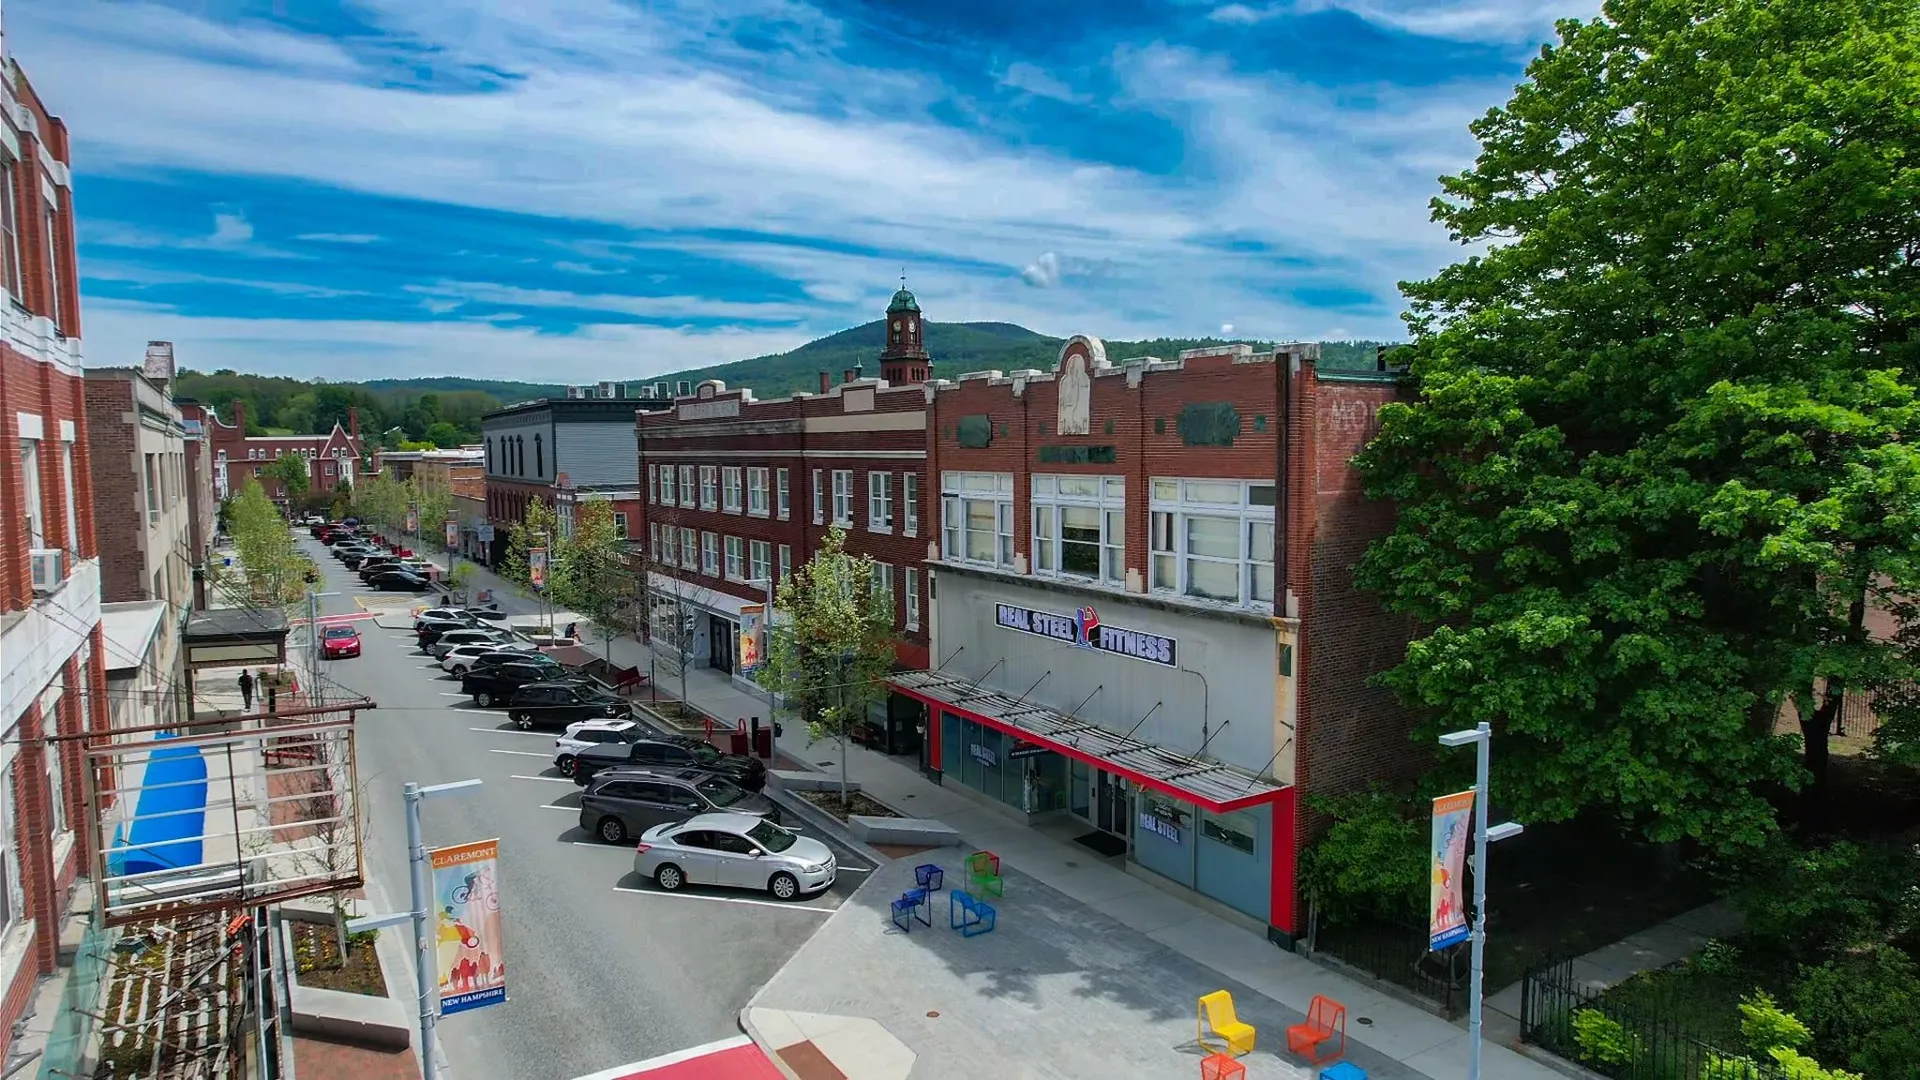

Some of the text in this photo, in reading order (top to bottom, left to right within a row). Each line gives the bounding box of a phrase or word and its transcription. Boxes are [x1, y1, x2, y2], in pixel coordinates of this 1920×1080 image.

[999, 606, 1171, 663] REAL STEEL FITNESS
[1140, 812, 1179, 843] REAL STEEL
[433, 847, 497, 867] CLAREMONT
[1431, 935, 1442, 944] NEW
[442, 988, 504, 1007] NEW HAMPSHIRE
